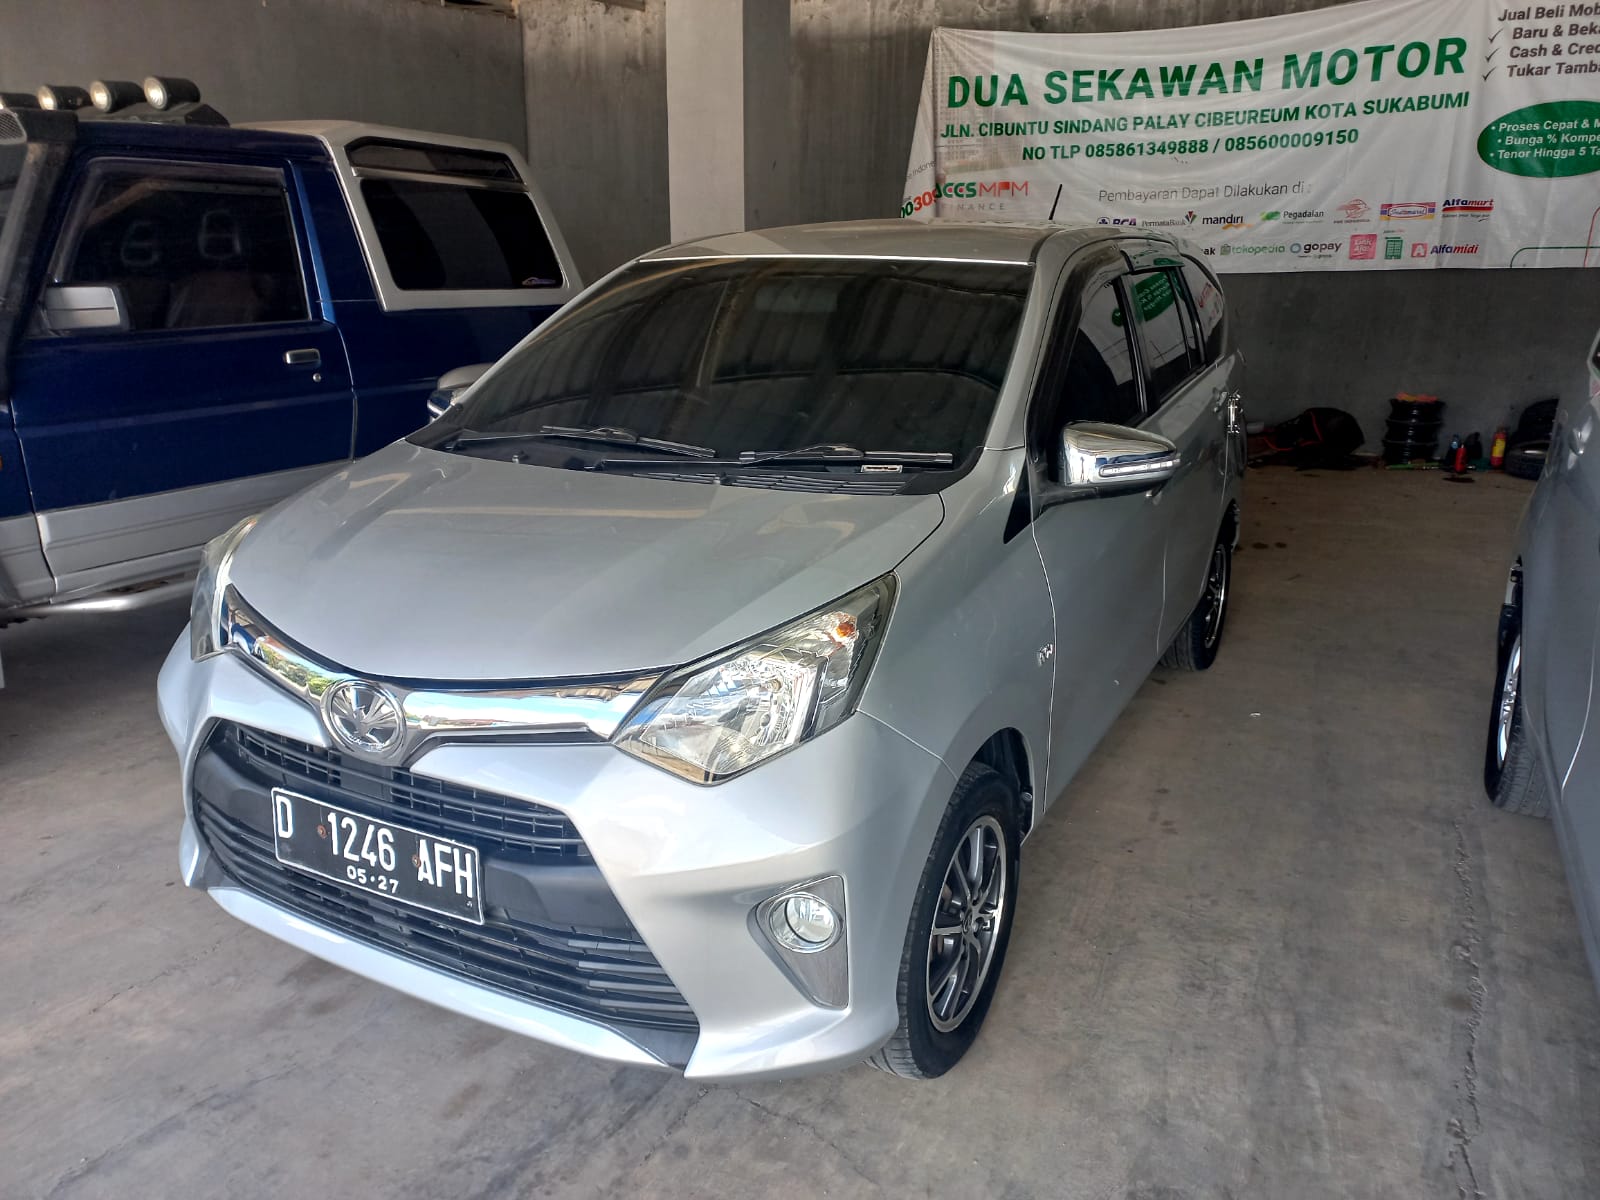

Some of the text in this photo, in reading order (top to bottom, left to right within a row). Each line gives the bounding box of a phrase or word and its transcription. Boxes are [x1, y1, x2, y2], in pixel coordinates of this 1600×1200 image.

[1498, 7, 1531, 22] Jual
[1534, 5, 1565, 20] Beli
[1512, 26, 1548, 40] Baru
[1552, 24, 1564, 37] &
[1509, 44, 1547, 58] Cash
[1552, 43, 1562, 56] &
[947, 37, 1468, 109] DUA SEKAWAN MOTOR
[1507, 64, 1551, 78] Tukar
[941, 91, 1470, 139] JLN. CIBUNTU SINDANG PALAY CIBEUREUM KOTA SUKABUMI
[1498, 121, 1540, 132] Proses
[1543, 118, 1578, 132] Cepat
[1581, 118, 1590, 129] &
[1022, 128, 1359, 161] NO TLP 085861349888 / 085600009150
[1505, 135, 1543, 147] Bunga
[1547, 134, 1557, 145] %
[1497, 149, 1531, 159] Tenor
[1534, 146, 1576, 159] Hingga
[1579, 146, 1587, 156] 5
[978, 180, 1029, 197] MPM
[1098, 189, 1179, 203] Pembayaran
[1181, 186, 1219, 201] Dapat
[1223, 182, 1288, 199] Dilakukan
[1442, 198, 1494, 207] Alfamart
[1202, 213, 1244, 225] mandiri
[1232, 243, 1286, 256] tokopedia
[1303, 241, 1343, 254] gopay
[1430, 244, 1480, 255] Alfamidi
[275, 795, 474, 899] D 1246 AFH
